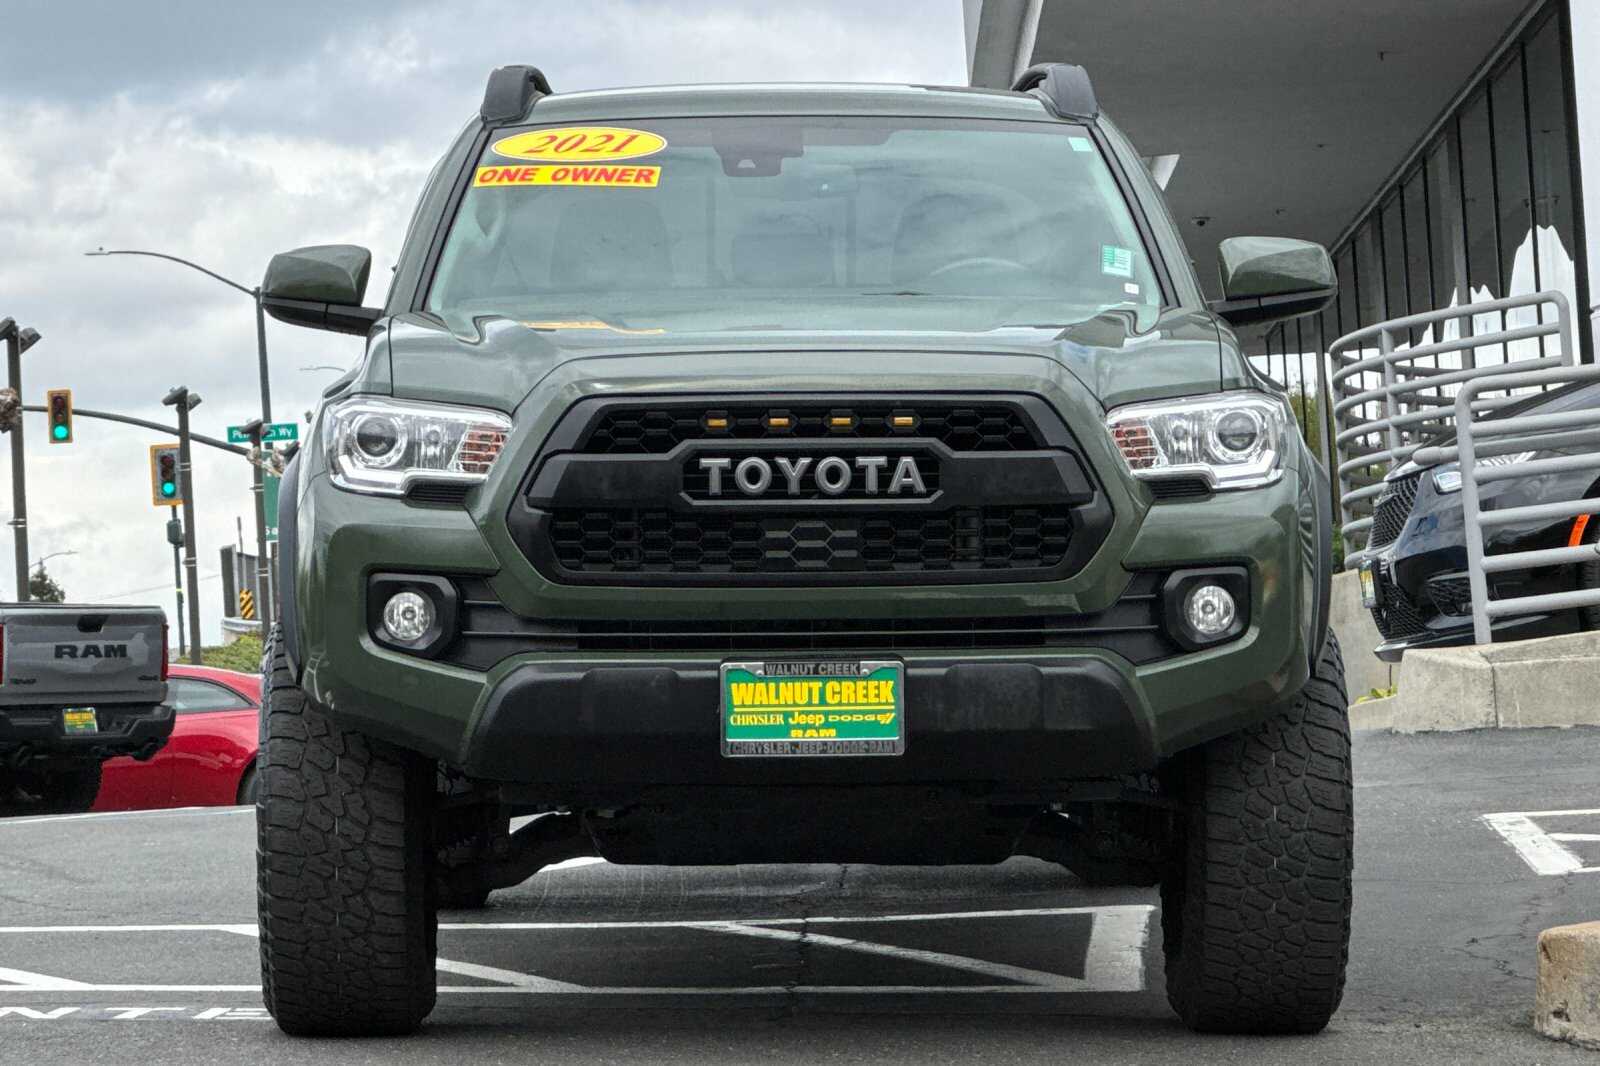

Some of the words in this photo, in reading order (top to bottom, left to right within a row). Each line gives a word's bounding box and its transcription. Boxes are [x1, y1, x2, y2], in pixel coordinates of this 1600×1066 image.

[523, 133, 640, 154] 2021
[479, 168, 540, 184] ONE
[550, 168, 656, 184] OWNER
[699, 456, 928, 496] TOYOTA
[54, 644, 128, 659] RAM
[765, 663, 815, 675] WALNUT
[818, 662, 860, 675] CREEK
[730, 681, 823, 705] WALNUT
[825, 680, 895, 704] CREEK
[730, 712, 785, 726] CHRYSLER
[788, 711, 825, 727] Jeep
[790, 728, 837, 738] RAM
